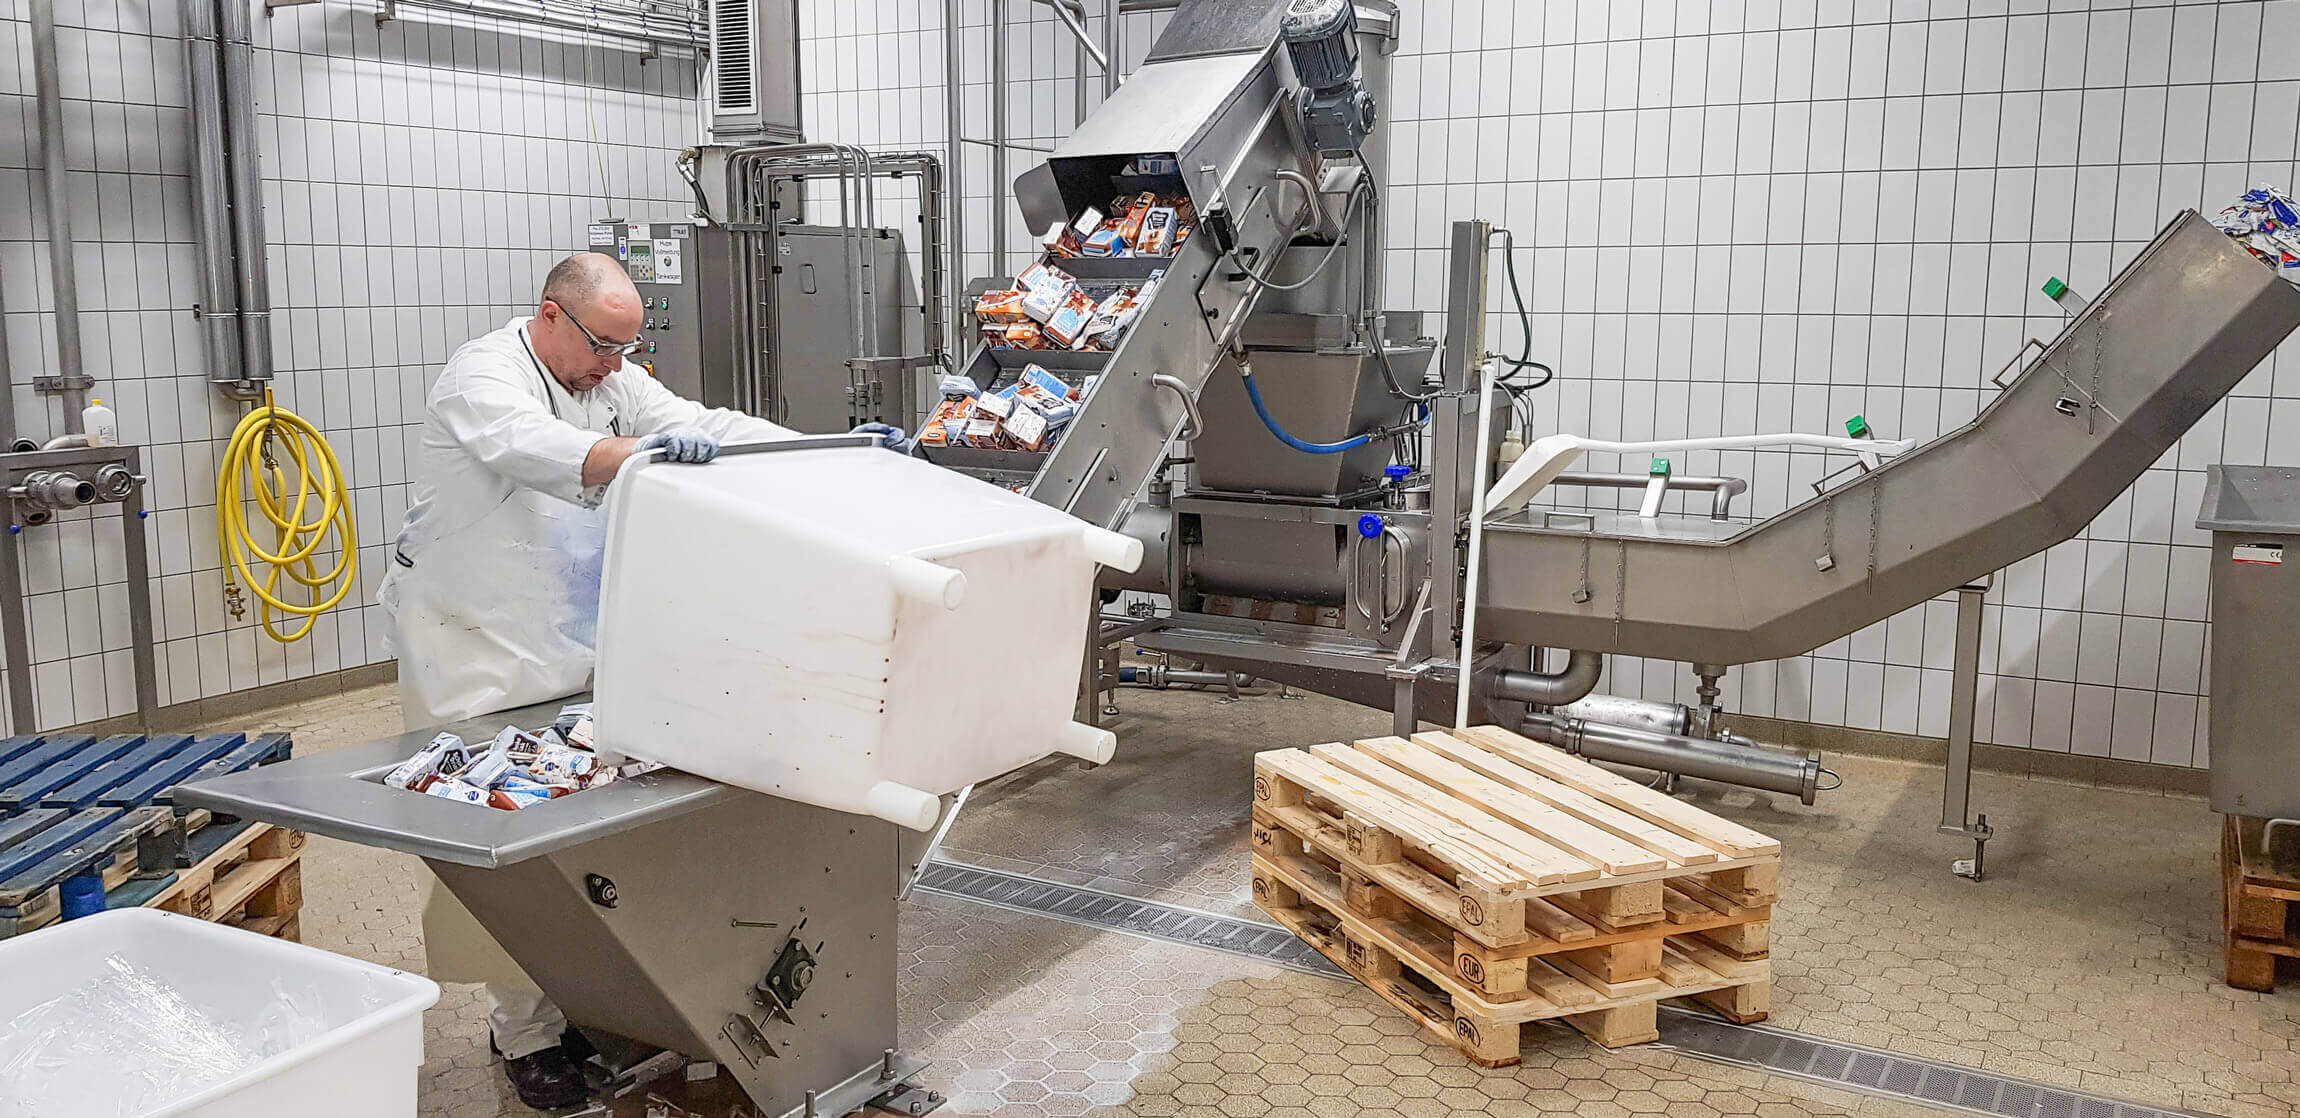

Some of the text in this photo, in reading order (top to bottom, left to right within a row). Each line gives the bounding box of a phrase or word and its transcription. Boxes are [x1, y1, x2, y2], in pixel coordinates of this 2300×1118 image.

[1461, 899, 1481, 923] EPAL
[1463, 956, 1480, 981] EUR
[1459, 1020, 1477, 1046] EPAL
